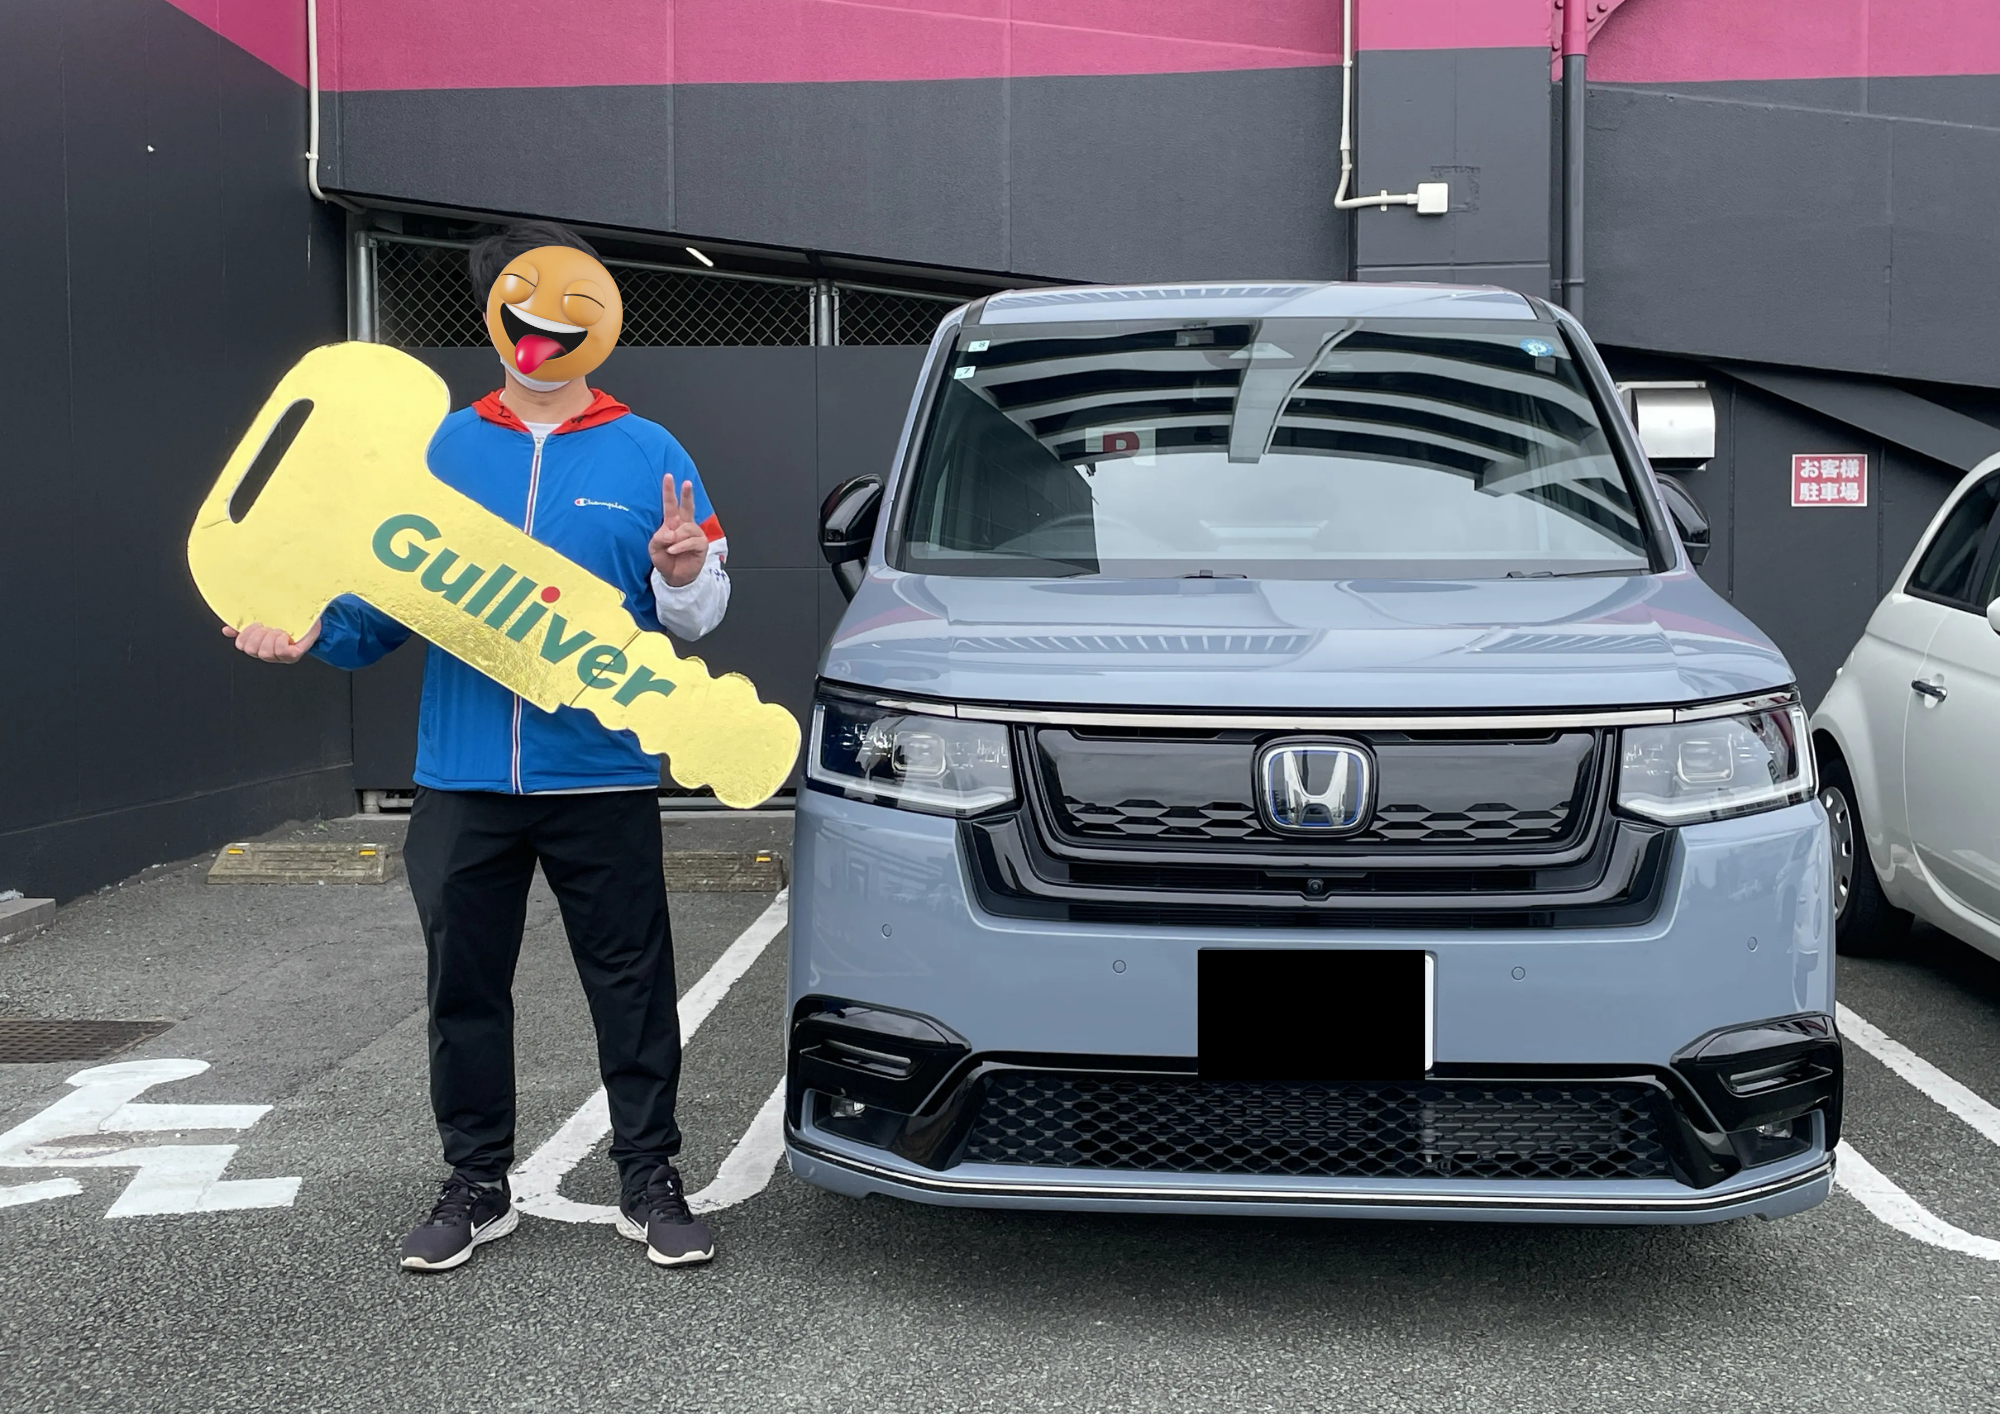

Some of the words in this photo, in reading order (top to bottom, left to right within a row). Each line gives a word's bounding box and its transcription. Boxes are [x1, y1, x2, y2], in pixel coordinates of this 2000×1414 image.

[1799, 459, 1860, 478] お客様
[1799, 482, 1860, 501] 駐車場
[574, 497, 629, 511] Champion
[372, 514, 677, 707] Gulliver
